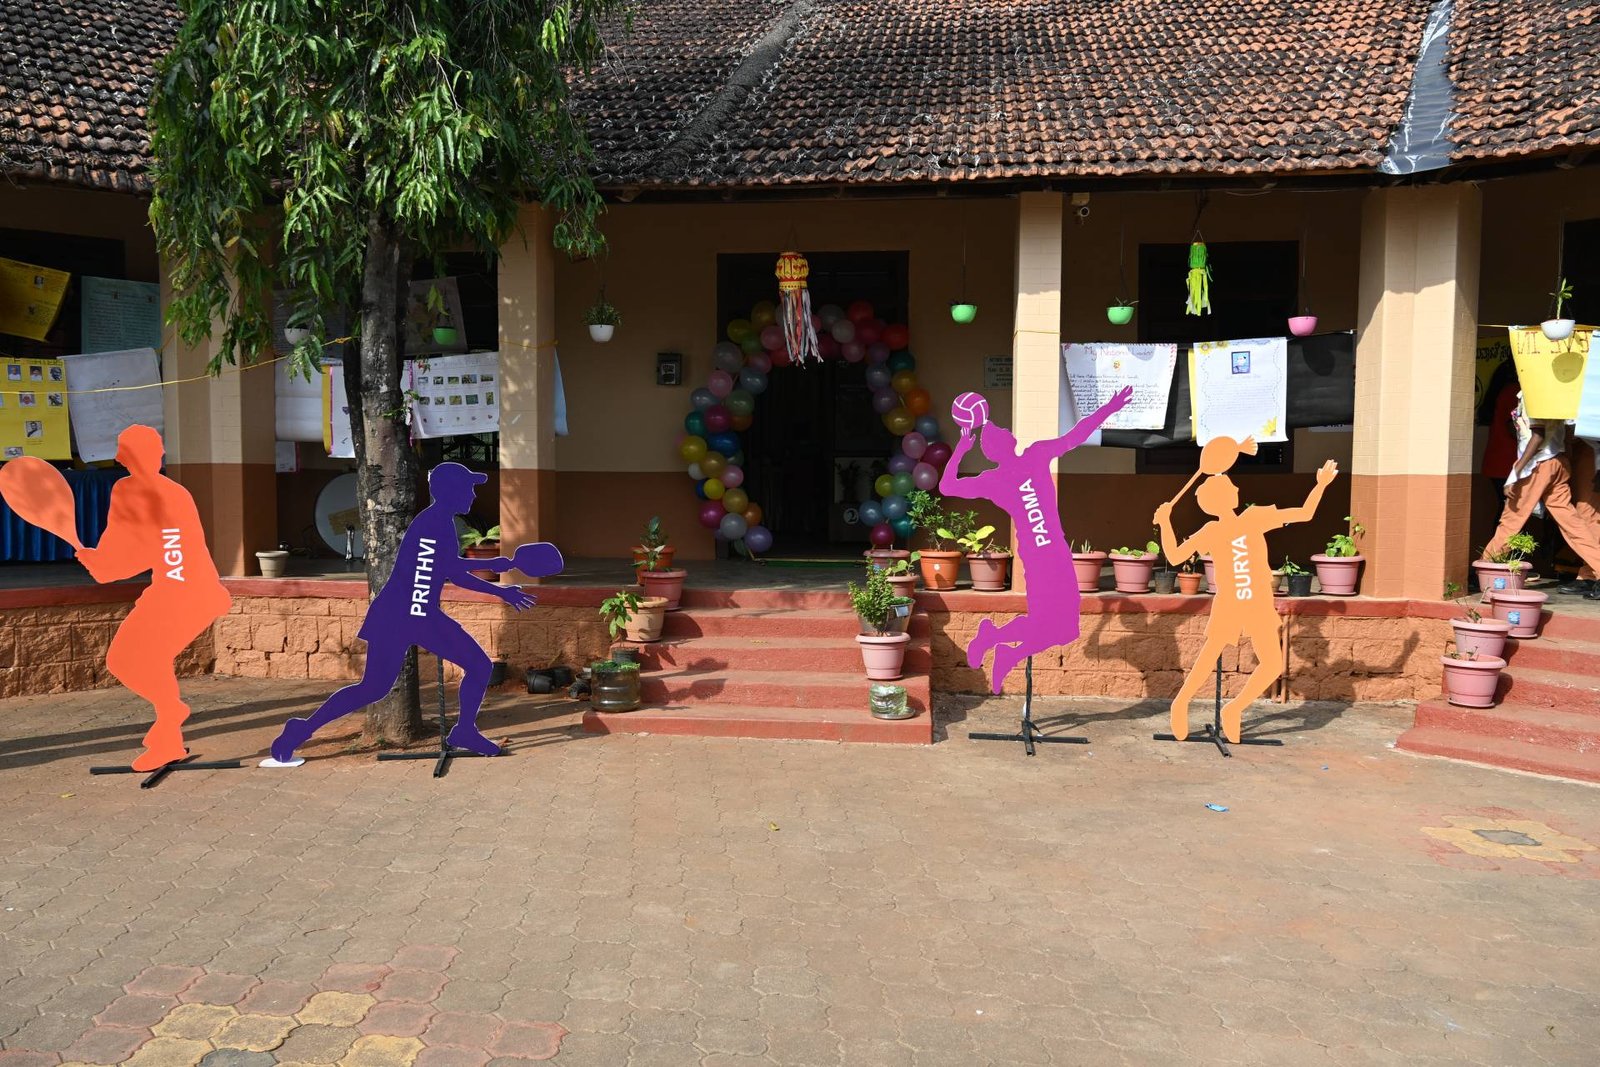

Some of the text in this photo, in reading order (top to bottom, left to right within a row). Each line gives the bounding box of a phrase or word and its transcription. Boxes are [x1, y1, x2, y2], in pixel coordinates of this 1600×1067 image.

[1019, 478, 1051, 547] PADMA
[162, 528, 185, 582] AGNI
[410, 538, 436, 617] PRITHVI
[1231, 535, 1252, 600] SURYA
